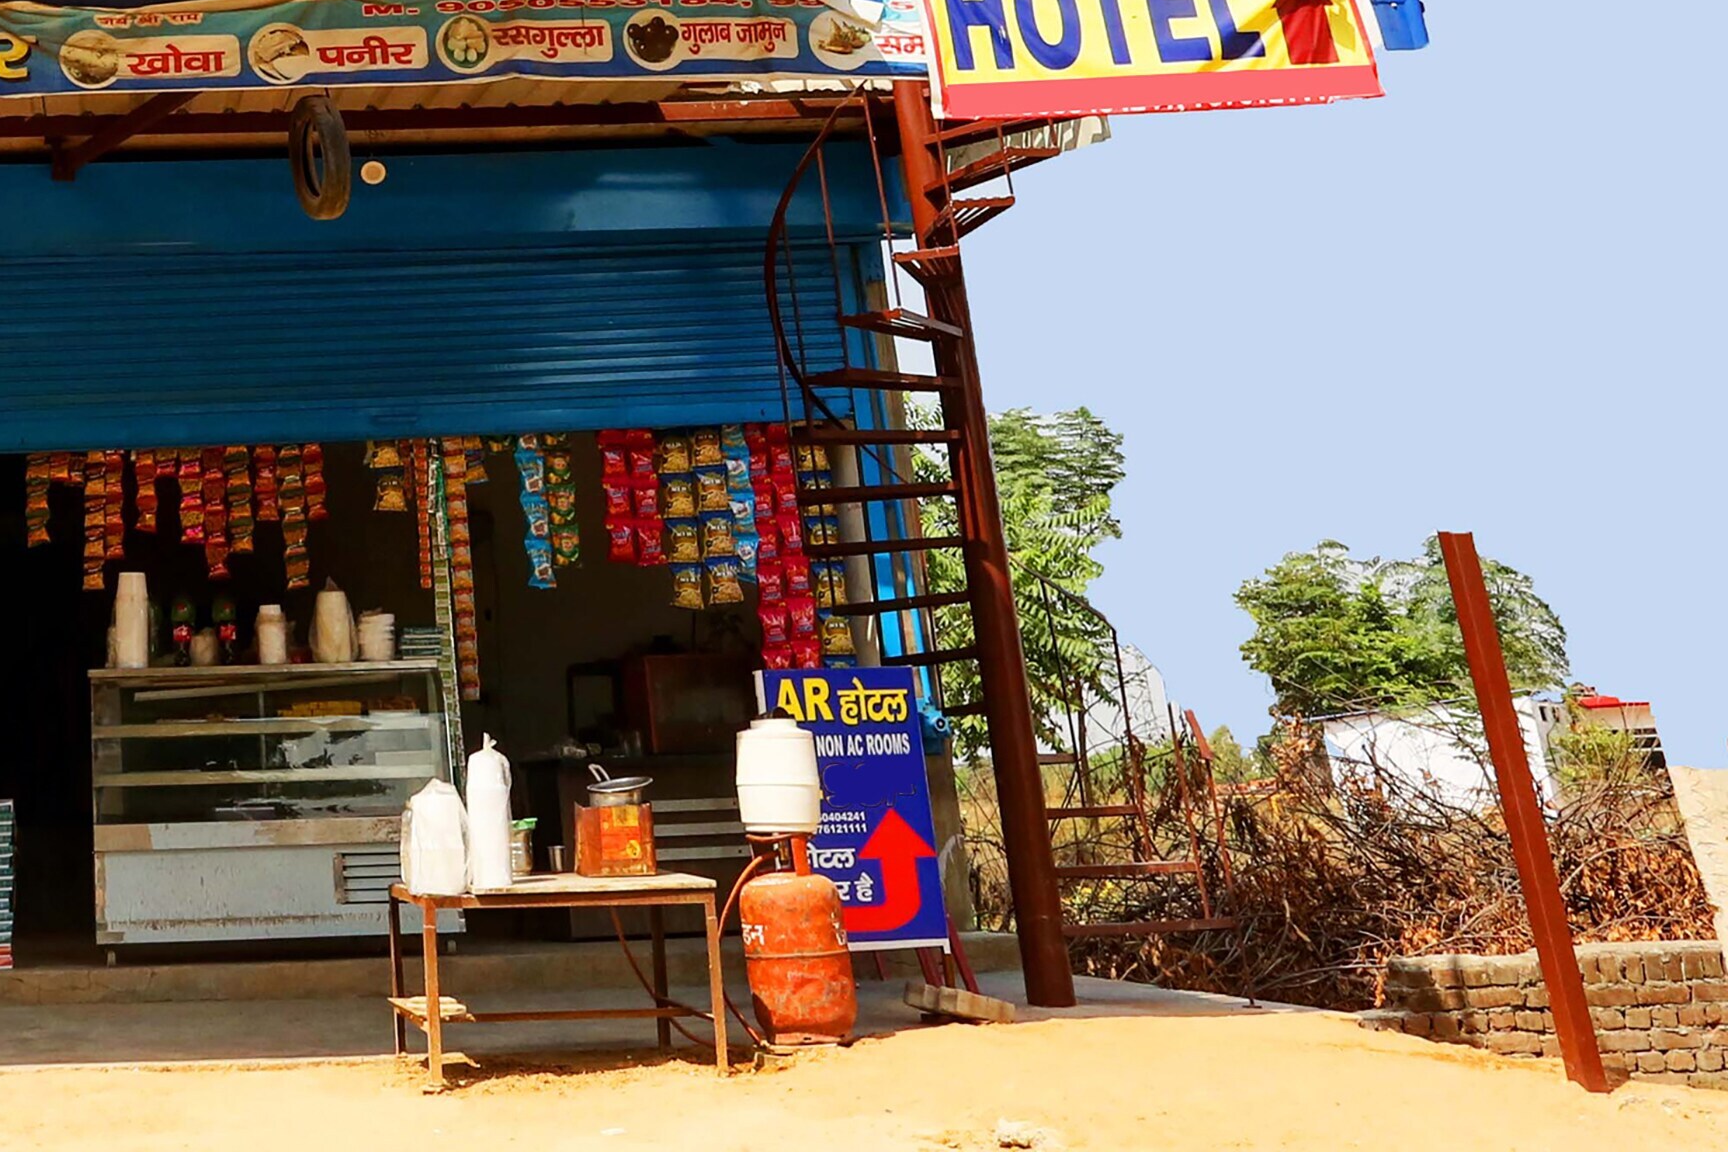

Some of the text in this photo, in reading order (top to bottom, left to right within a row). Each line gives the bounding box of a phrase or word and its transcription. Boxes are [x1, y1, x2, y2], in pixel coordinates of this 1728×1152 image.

[316, 35, 416, 66] पनीर
[491, 25, 605, 59] रसगुल्ला
[680, 21, 787, 54] गुलाब जामुन
[125, 43, 226, 76] खोवा
[777, 676, 908, 725] AR होटल
[815, 732, 910, 757] NON AC ROOMS
[813, 823, 867, 835] 76121111
[820, 811, 866, 823] 0404241
[854, 871, 874, 902] है
